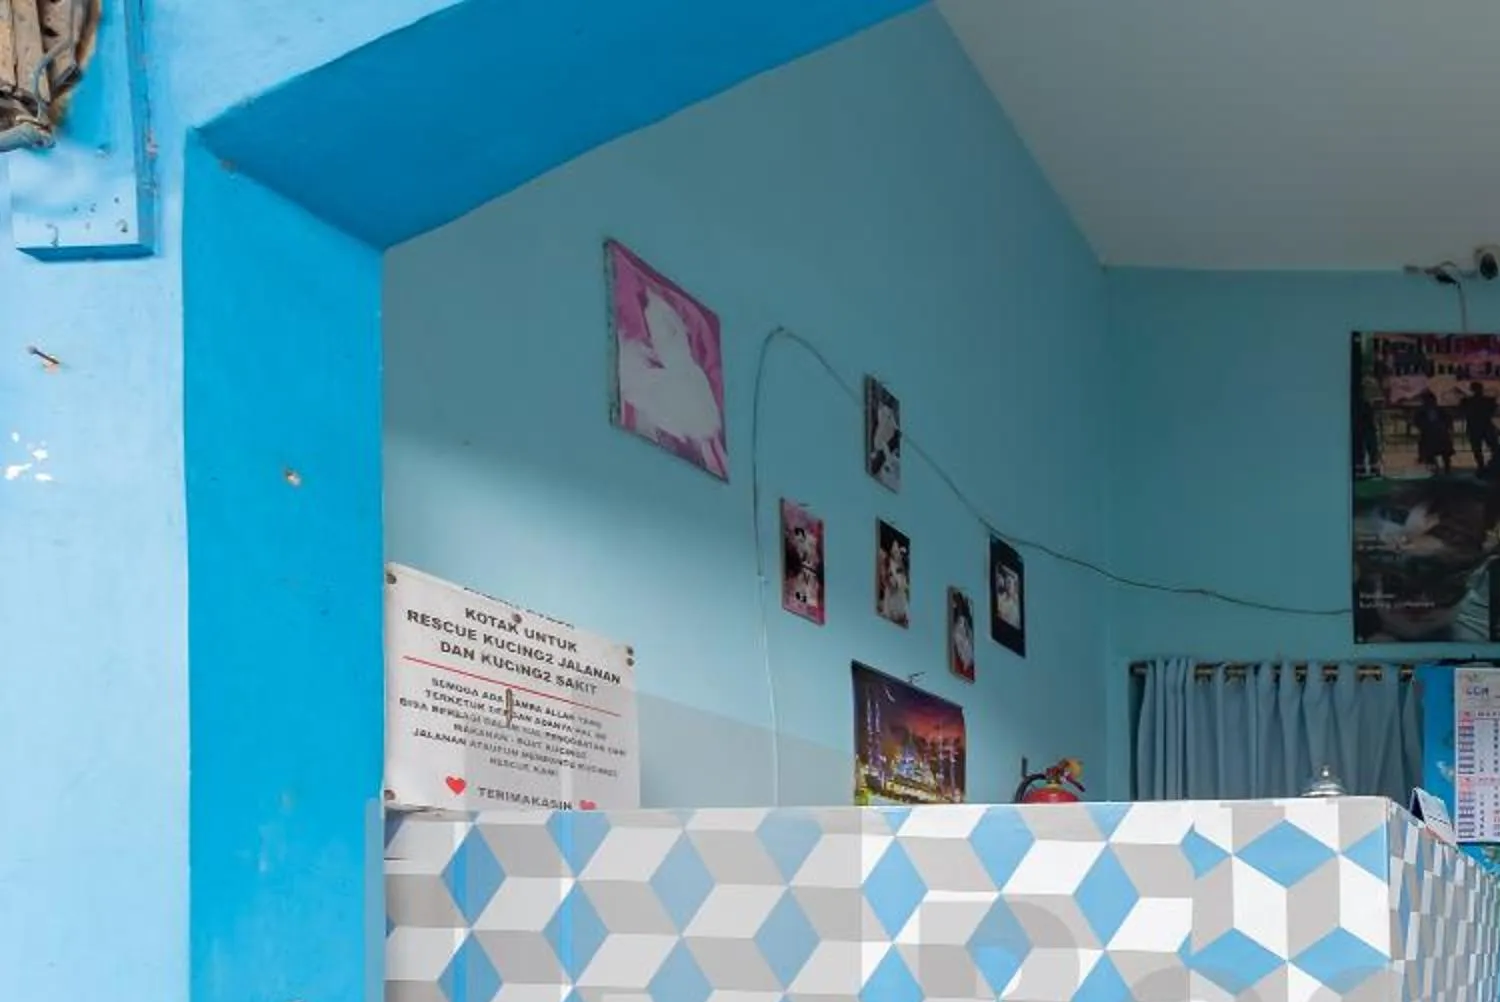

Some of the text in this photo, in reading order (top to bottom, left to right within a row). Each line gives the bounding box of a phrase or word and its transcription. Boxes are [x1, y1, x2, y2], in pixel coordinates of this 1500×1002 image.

[407, 609, 621, 684] RESCUE KUCING2 JALANAN
[465, 607, 577, 652] KOTAK UNTUK
[440, 641, 475, 661] DAN
[556, 675, 597, 695] SAKIT
